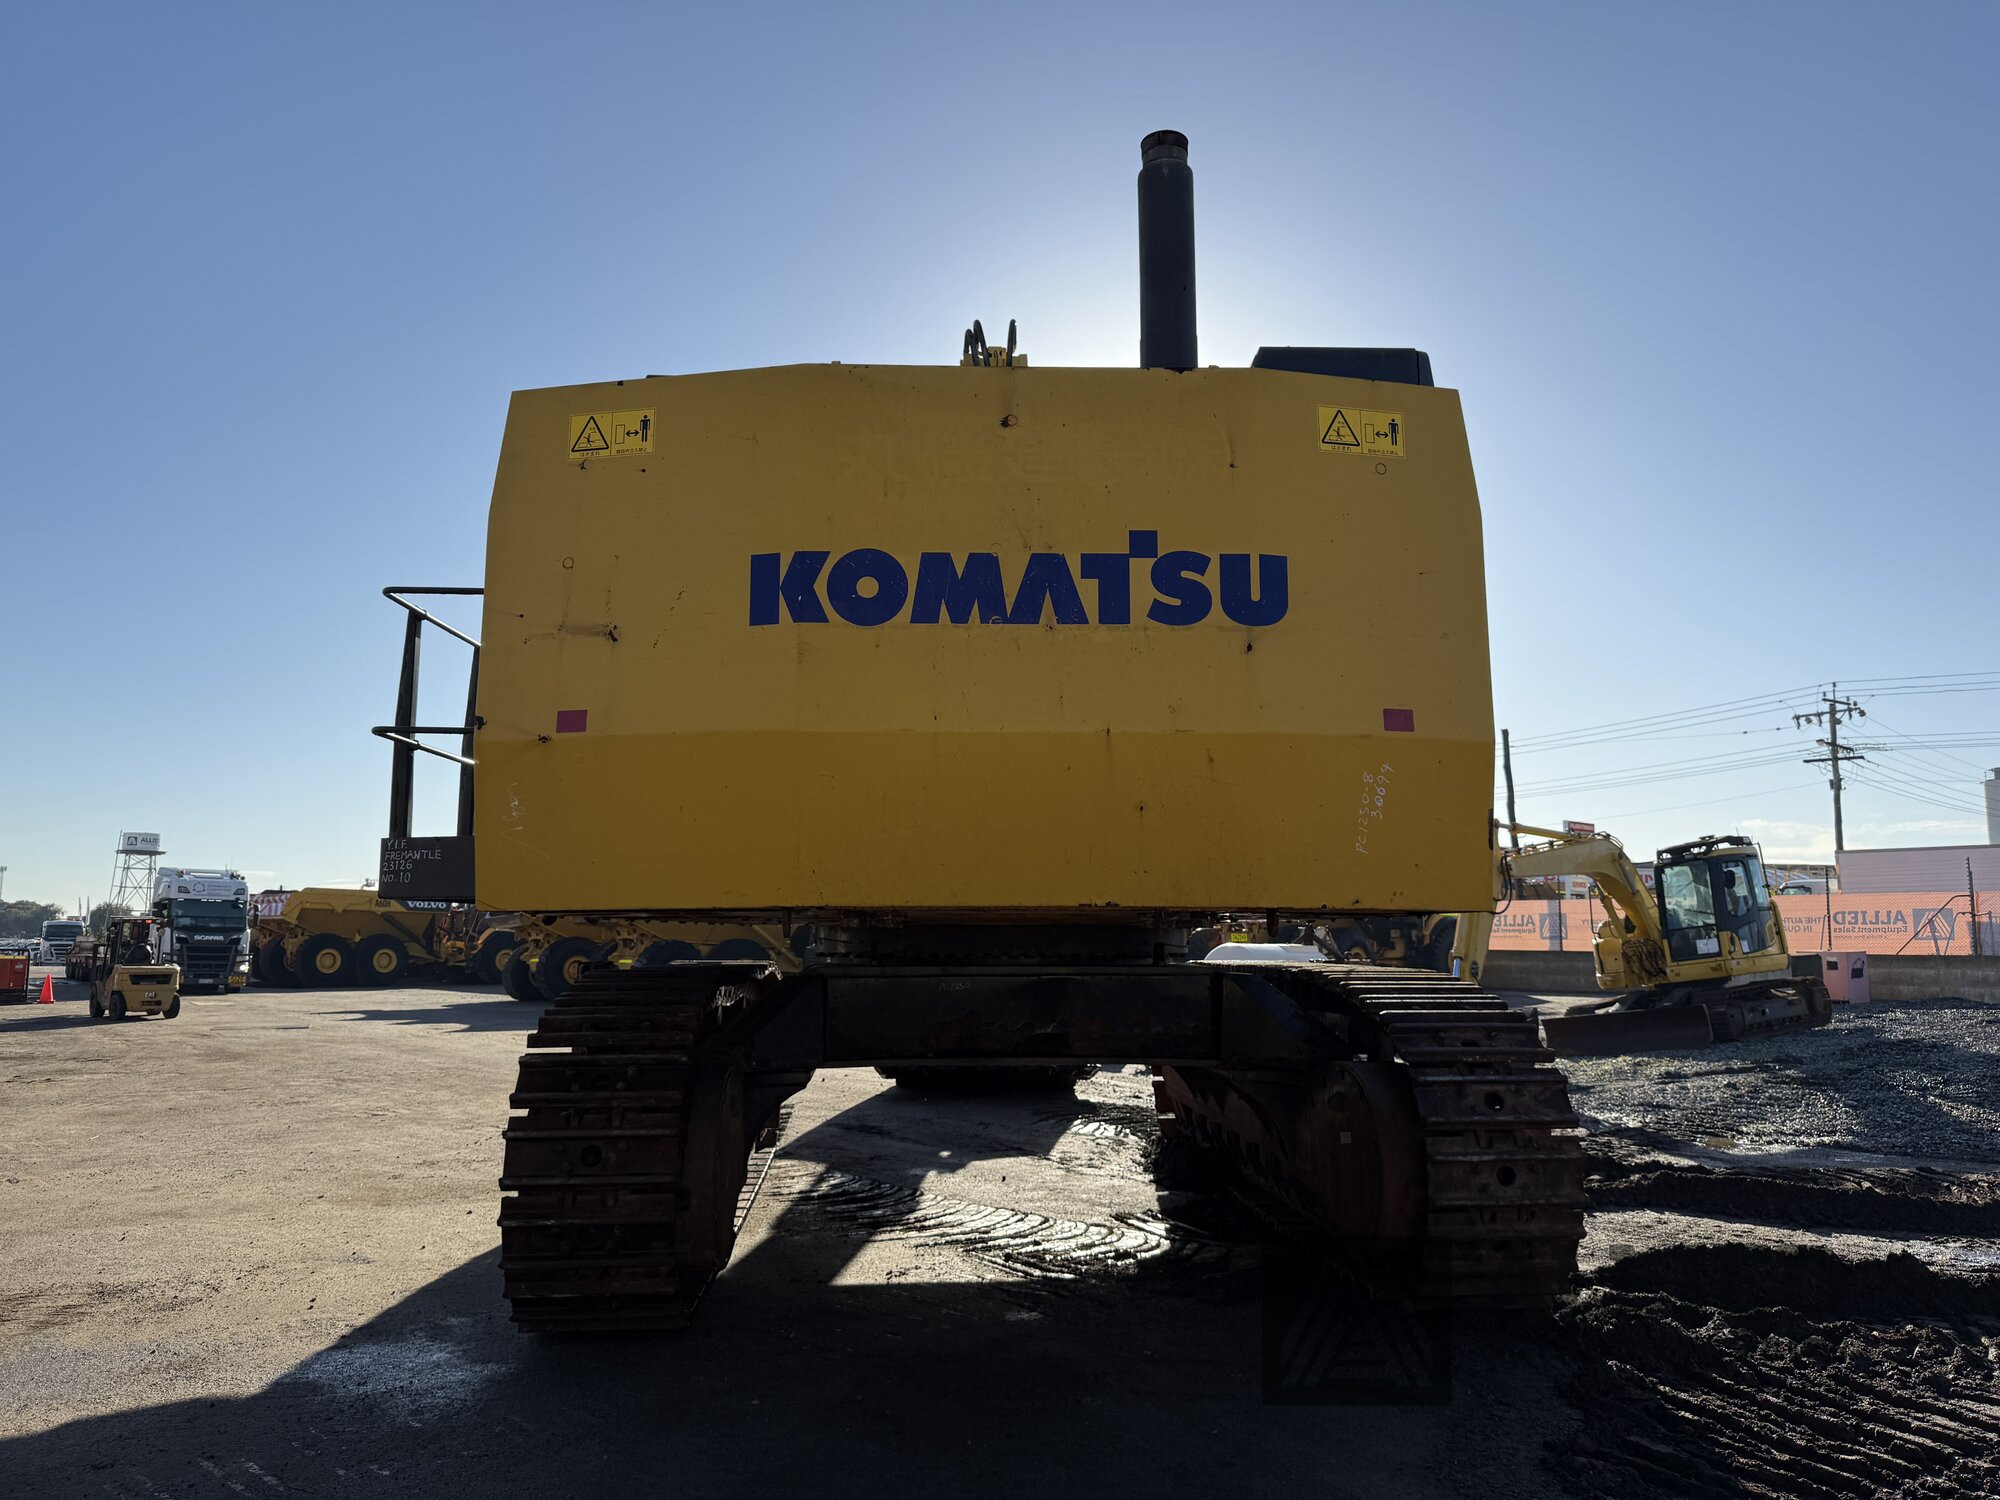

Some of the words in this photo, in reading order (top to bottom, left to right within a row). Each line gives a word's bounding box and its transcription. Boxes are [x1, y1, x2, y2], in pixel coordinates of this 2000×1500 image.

[749, 530, 1289, 627] KOMATSU
[384, 849, 442, 861] FREMANTLE
[382, 859, 413, 871] 23126
[406, 900, 447, 909] VOLVO
